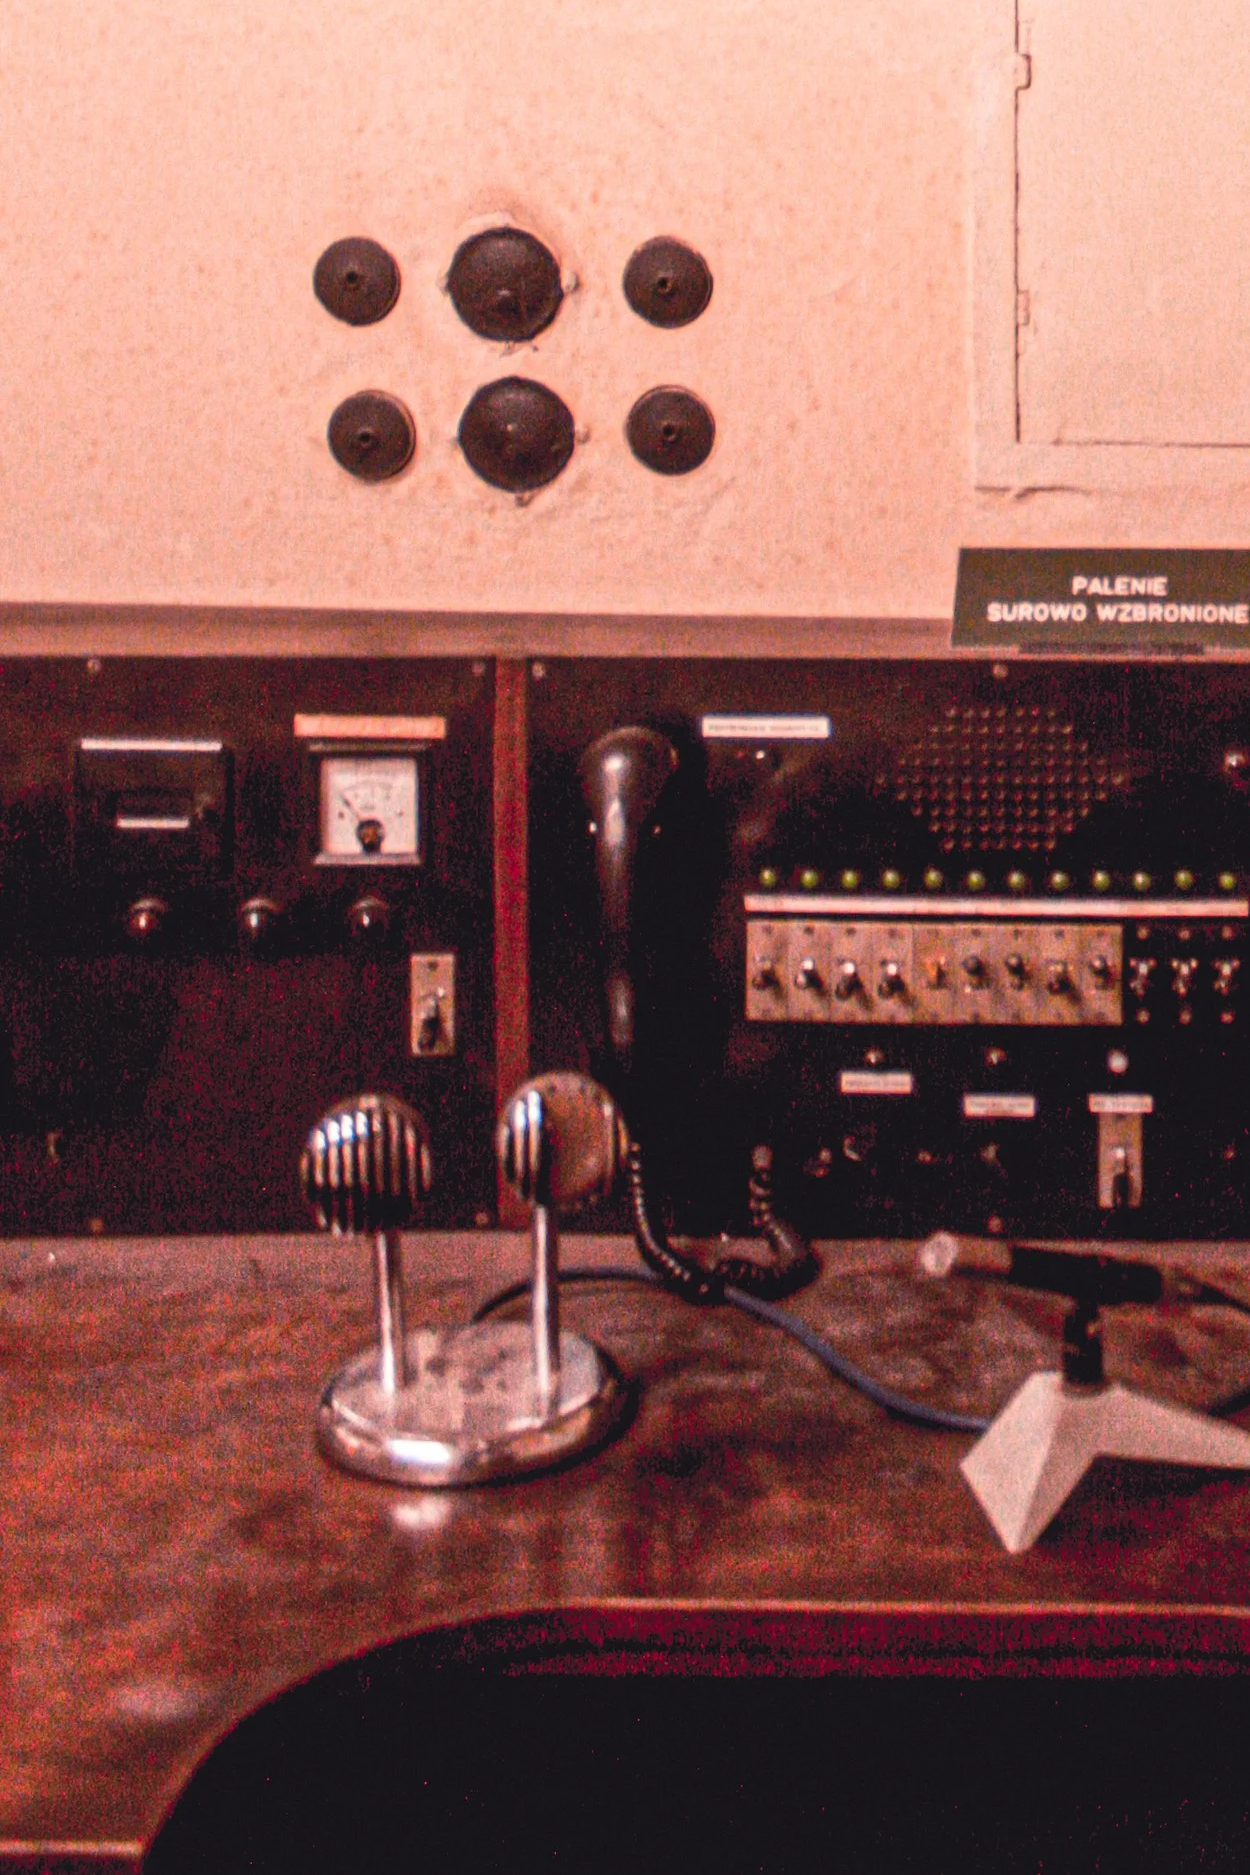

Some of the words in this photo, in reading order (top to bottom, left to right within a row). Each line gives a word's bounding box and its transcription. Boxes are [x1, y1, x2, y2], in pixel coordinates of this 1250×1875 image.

[1071, 575, 1169, 596] PALENIE
[986, 601, 1088, 623] SUROWO
[1096, 602, 1250, 625] WZBRONIONE
